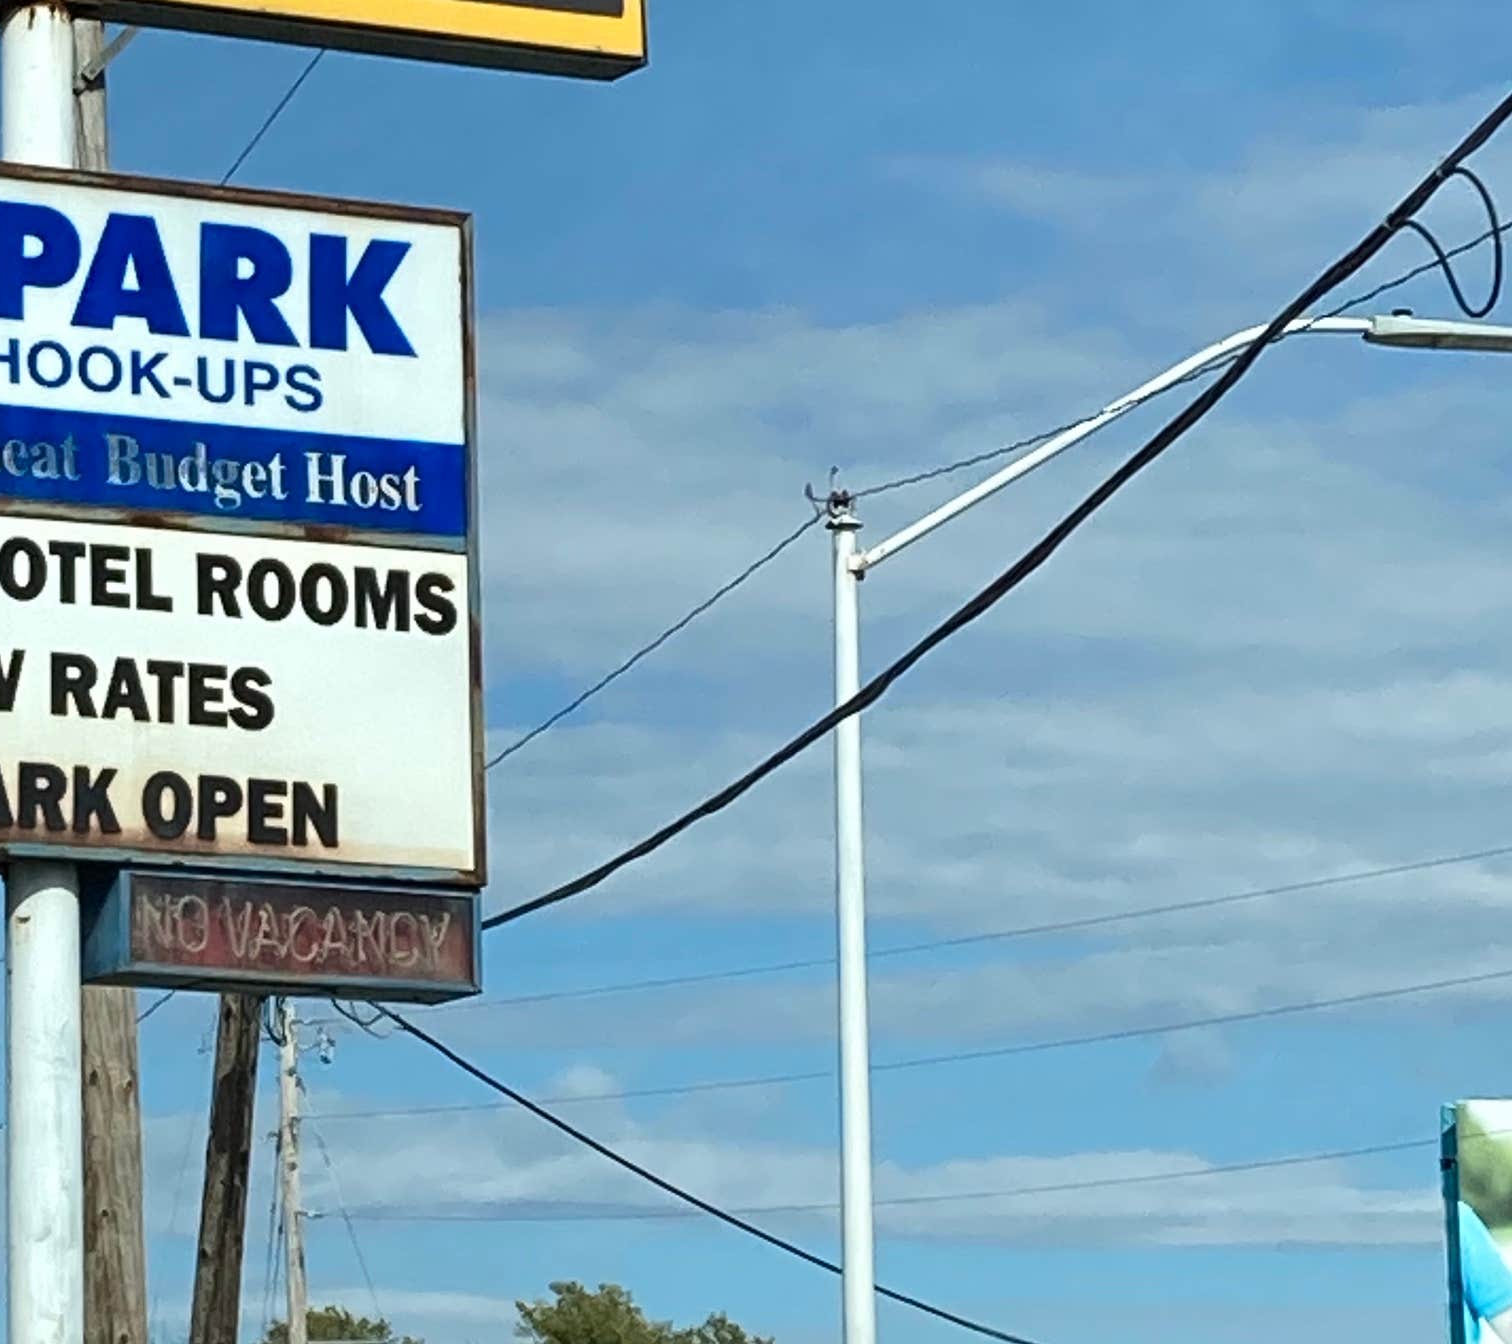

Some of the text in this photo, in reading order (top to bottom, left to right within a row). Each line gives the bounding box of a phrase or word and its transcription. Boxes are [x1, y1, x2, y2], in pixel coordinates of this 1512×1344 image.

[104, 431, 288, 508] Budget
[303, 459, 423, 513] Host
[196, 550, 459, 637] ROOMS
[49, 650, 276, 732] RATES
[141, 769, 339, 849] OPEN
[136, 892, 452, 970] NO VACANCY
